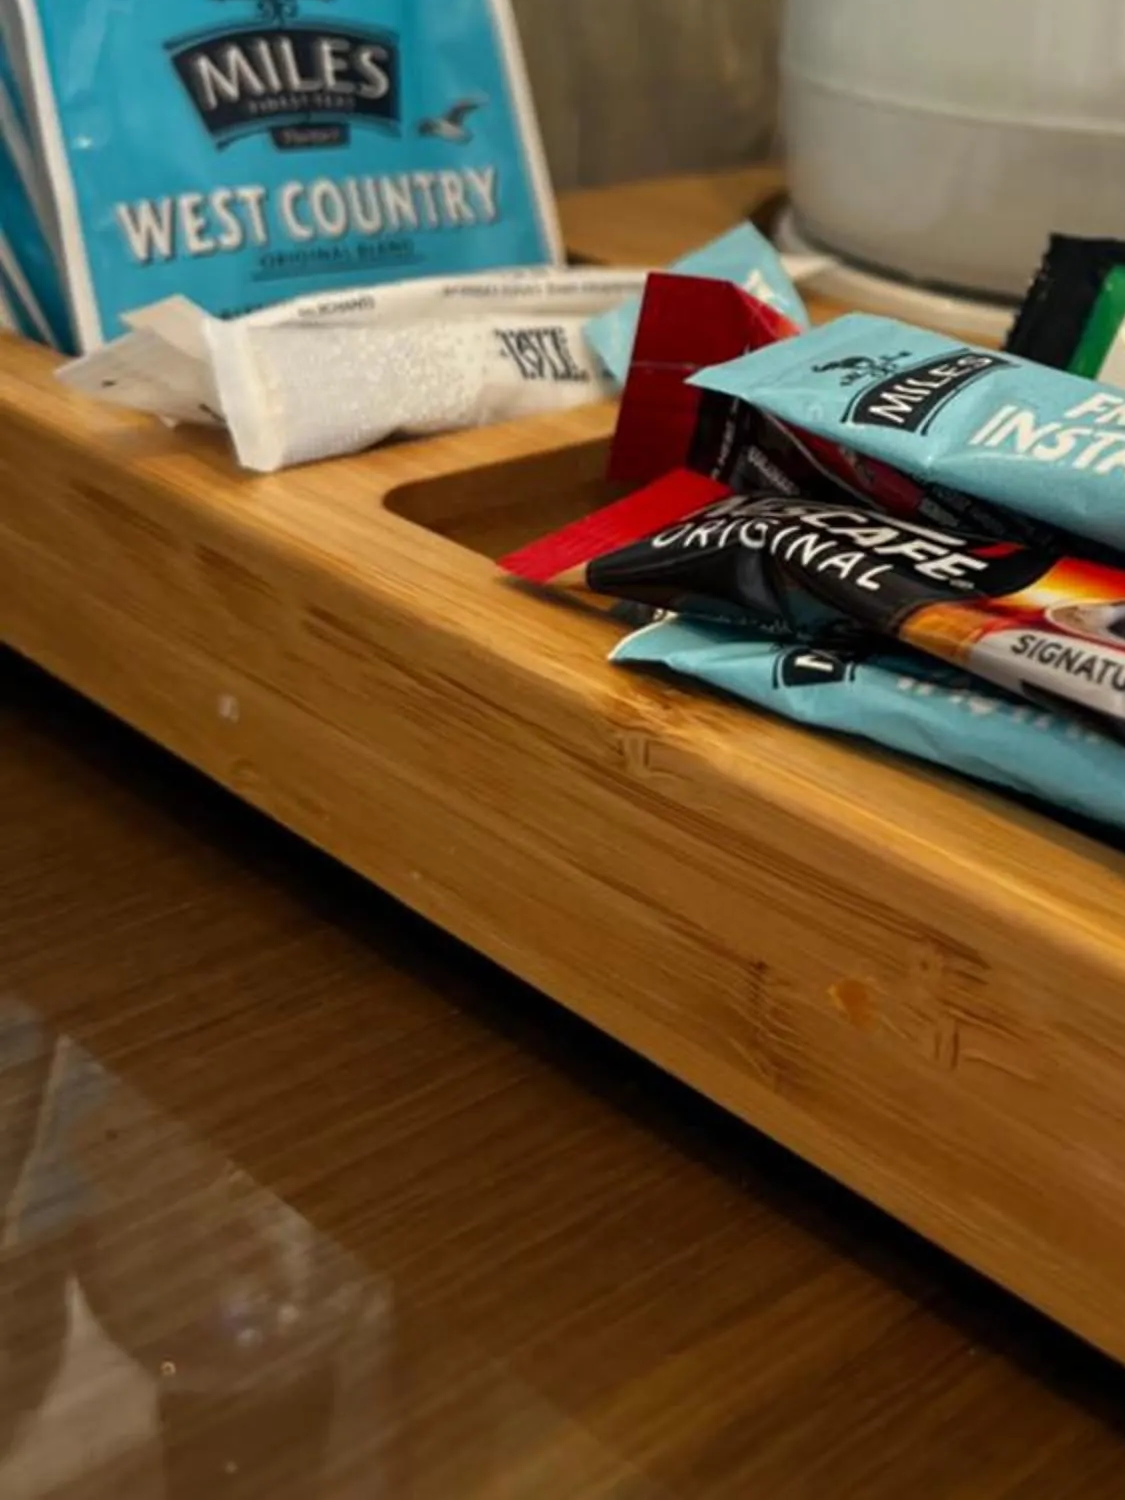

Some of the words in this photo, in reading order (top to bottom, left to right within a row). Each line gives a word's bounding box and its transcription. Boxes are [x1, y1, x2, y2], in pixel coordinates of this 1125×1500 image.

[195, 36, 390, 109] MILES
[116, 185, 268, 261] WEST
[282, 167, 499, 241] COUNTRY
[868, 355, 993, 424] MILES
[651, 517, 894, 591] ORIGINAL
